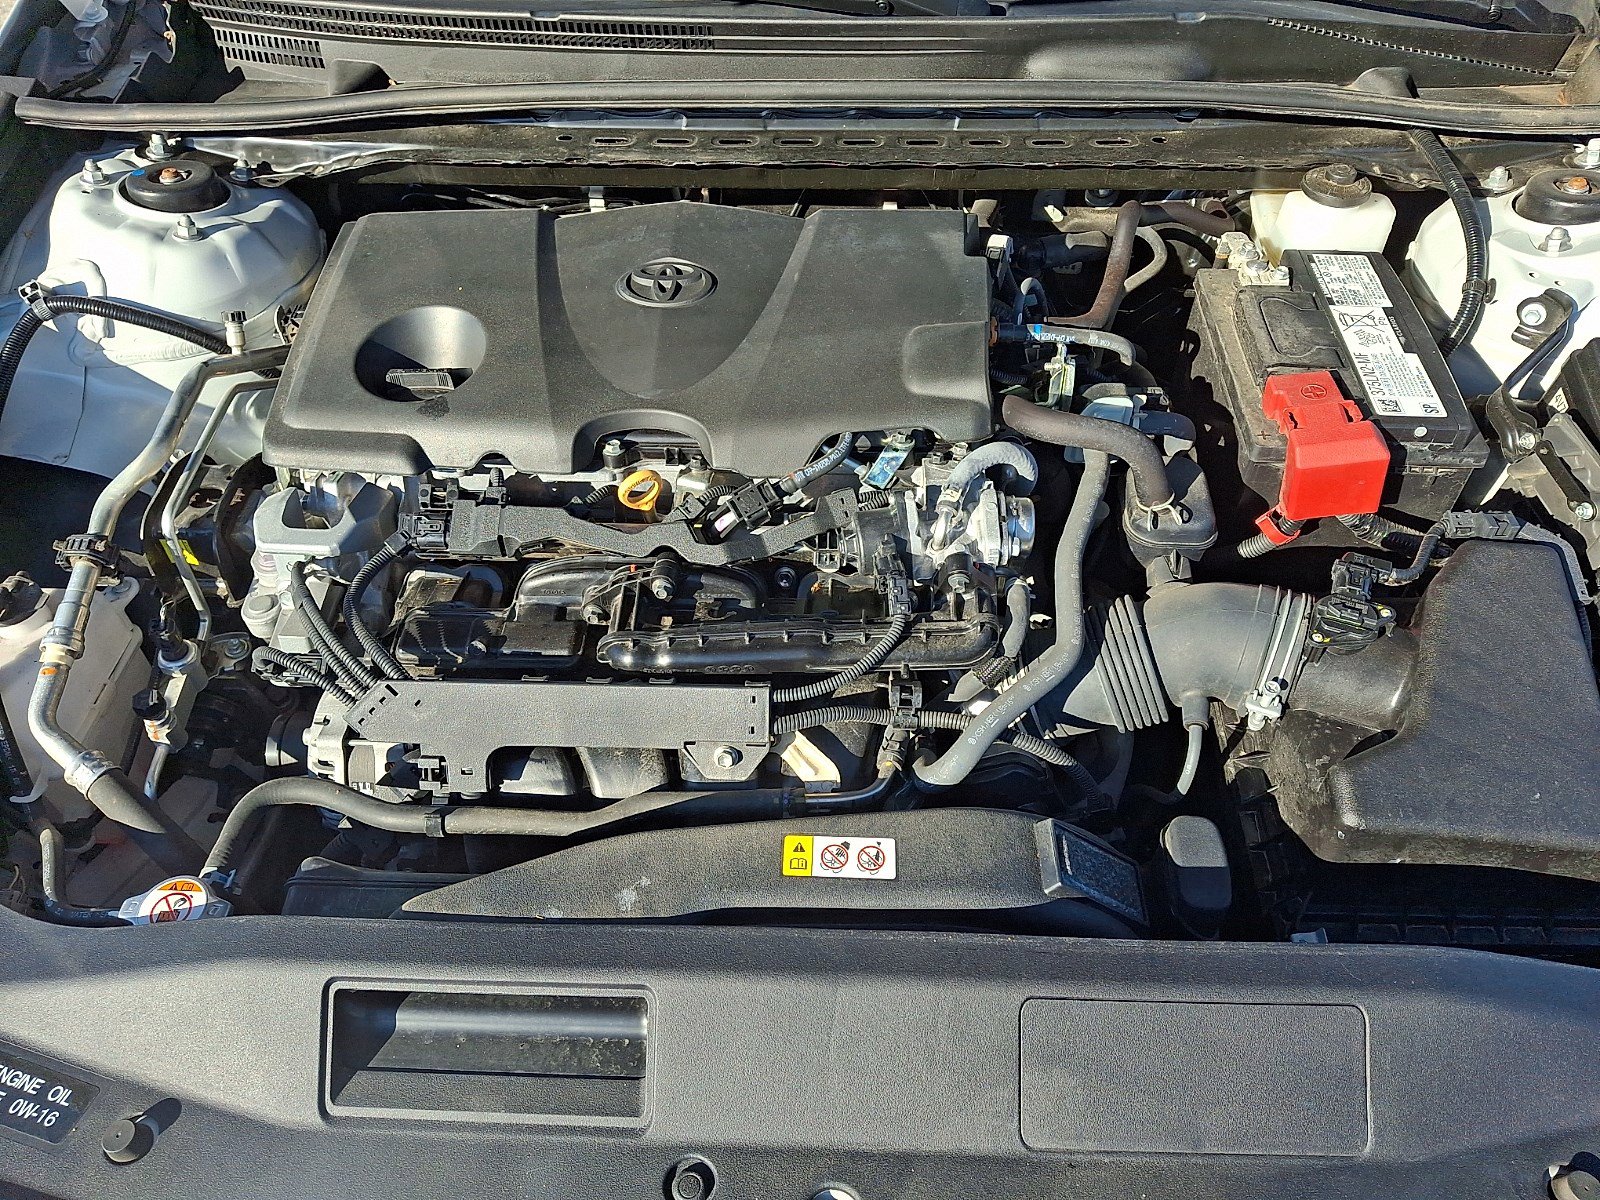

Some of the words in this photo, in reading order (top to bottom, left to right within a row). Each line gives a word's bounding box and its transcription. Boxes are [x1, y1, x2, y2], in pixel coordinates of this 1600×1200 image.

[1378, 316, 1388, 326] Pb
[1388, 316, 1404, 338] CLARIOS
[1353, 352, 1386, 396] 375LN2-MF
[1422, 403, 1440, 415] SP
[47, 1085, 72, 1107] OIL
[8, 1098, 60, 1127] 0W-16
